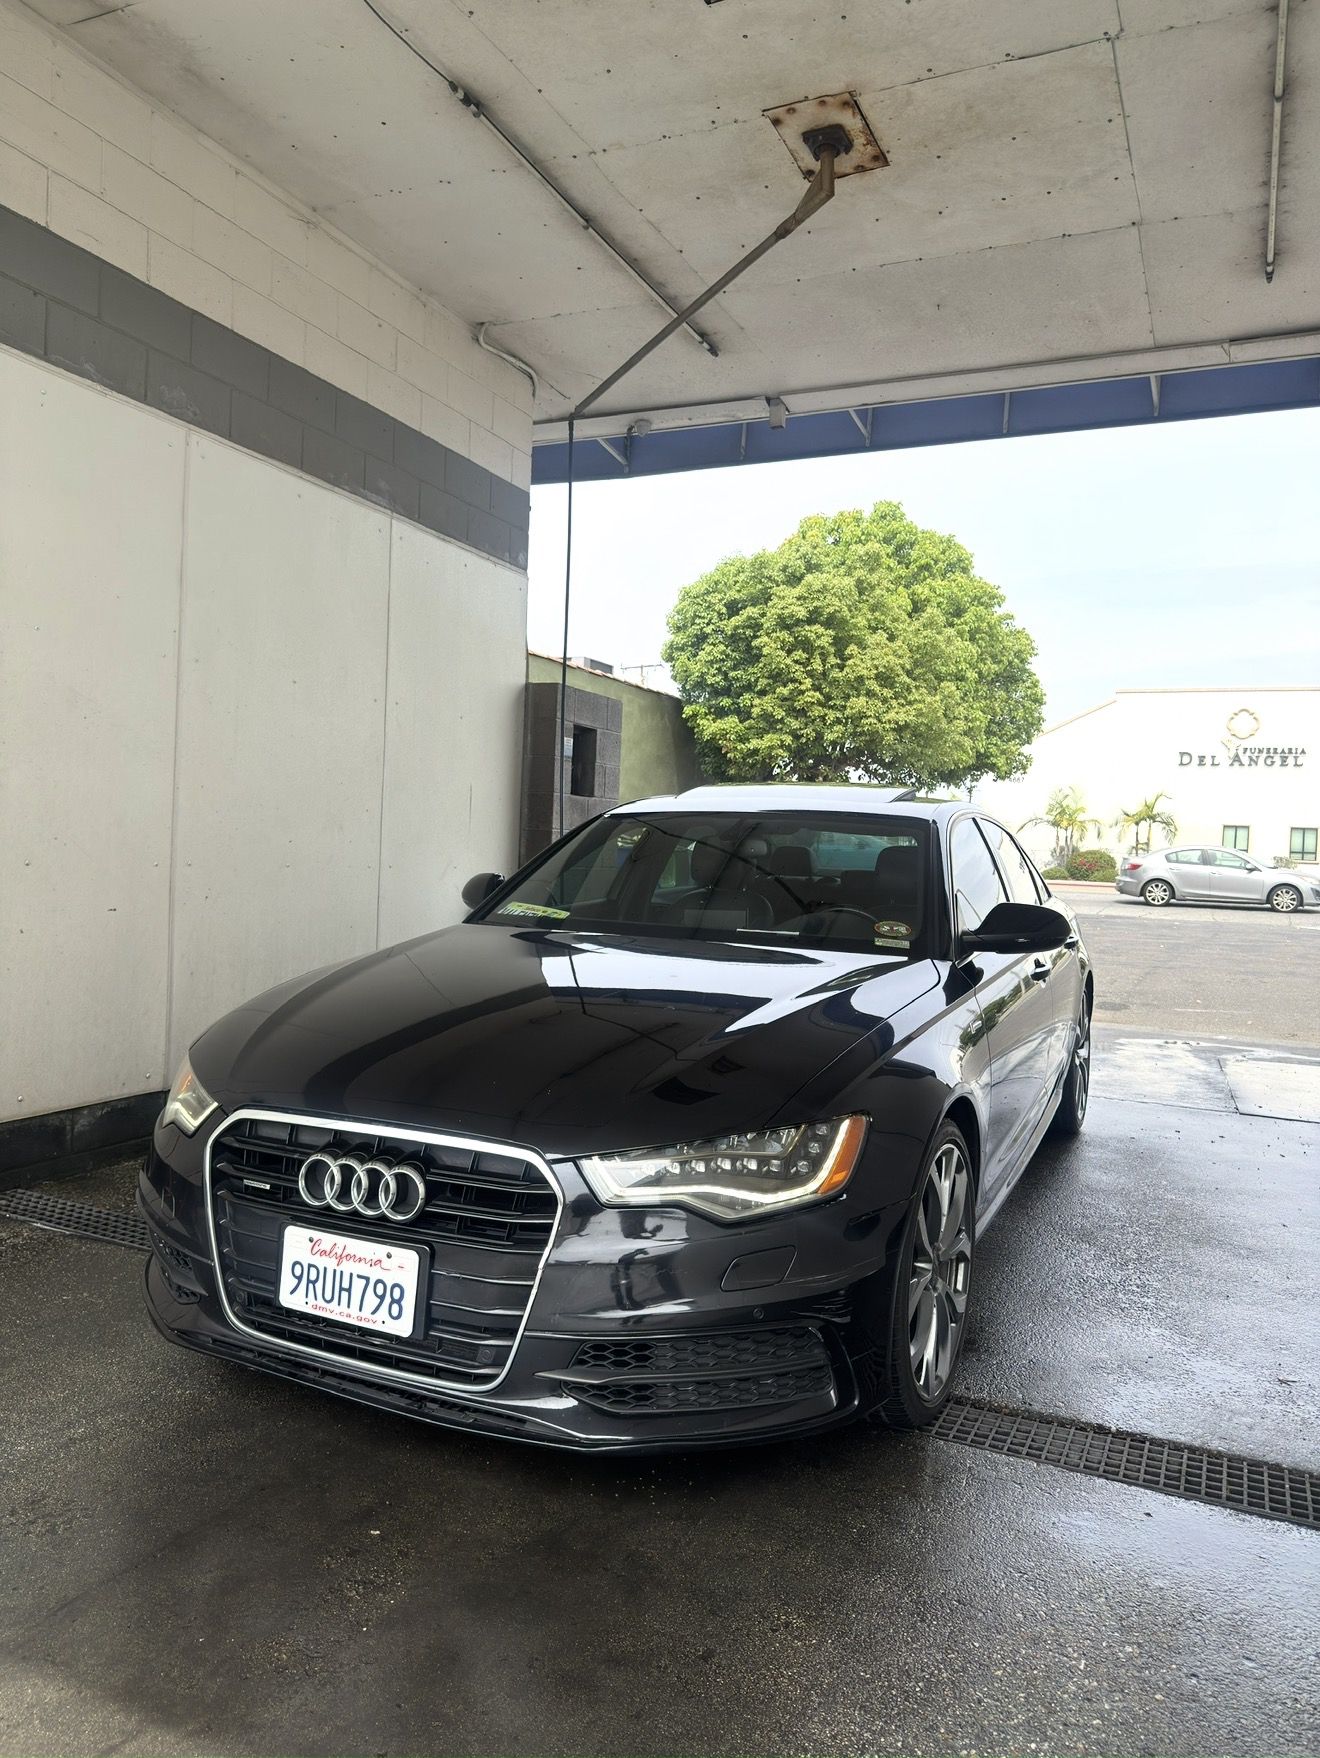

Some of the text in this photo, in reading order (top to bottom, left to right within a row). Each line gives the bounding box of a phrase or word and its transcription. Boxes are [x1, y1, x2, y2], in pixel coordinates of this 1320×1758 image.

[1242, 747, 1307, 755] FUNERARIA
[310, 1238, 392, 1271] California
[289, 1260, 405, 1321] 9RUH798
[311, 1303, 378, 1325] dmv.ca.gov
